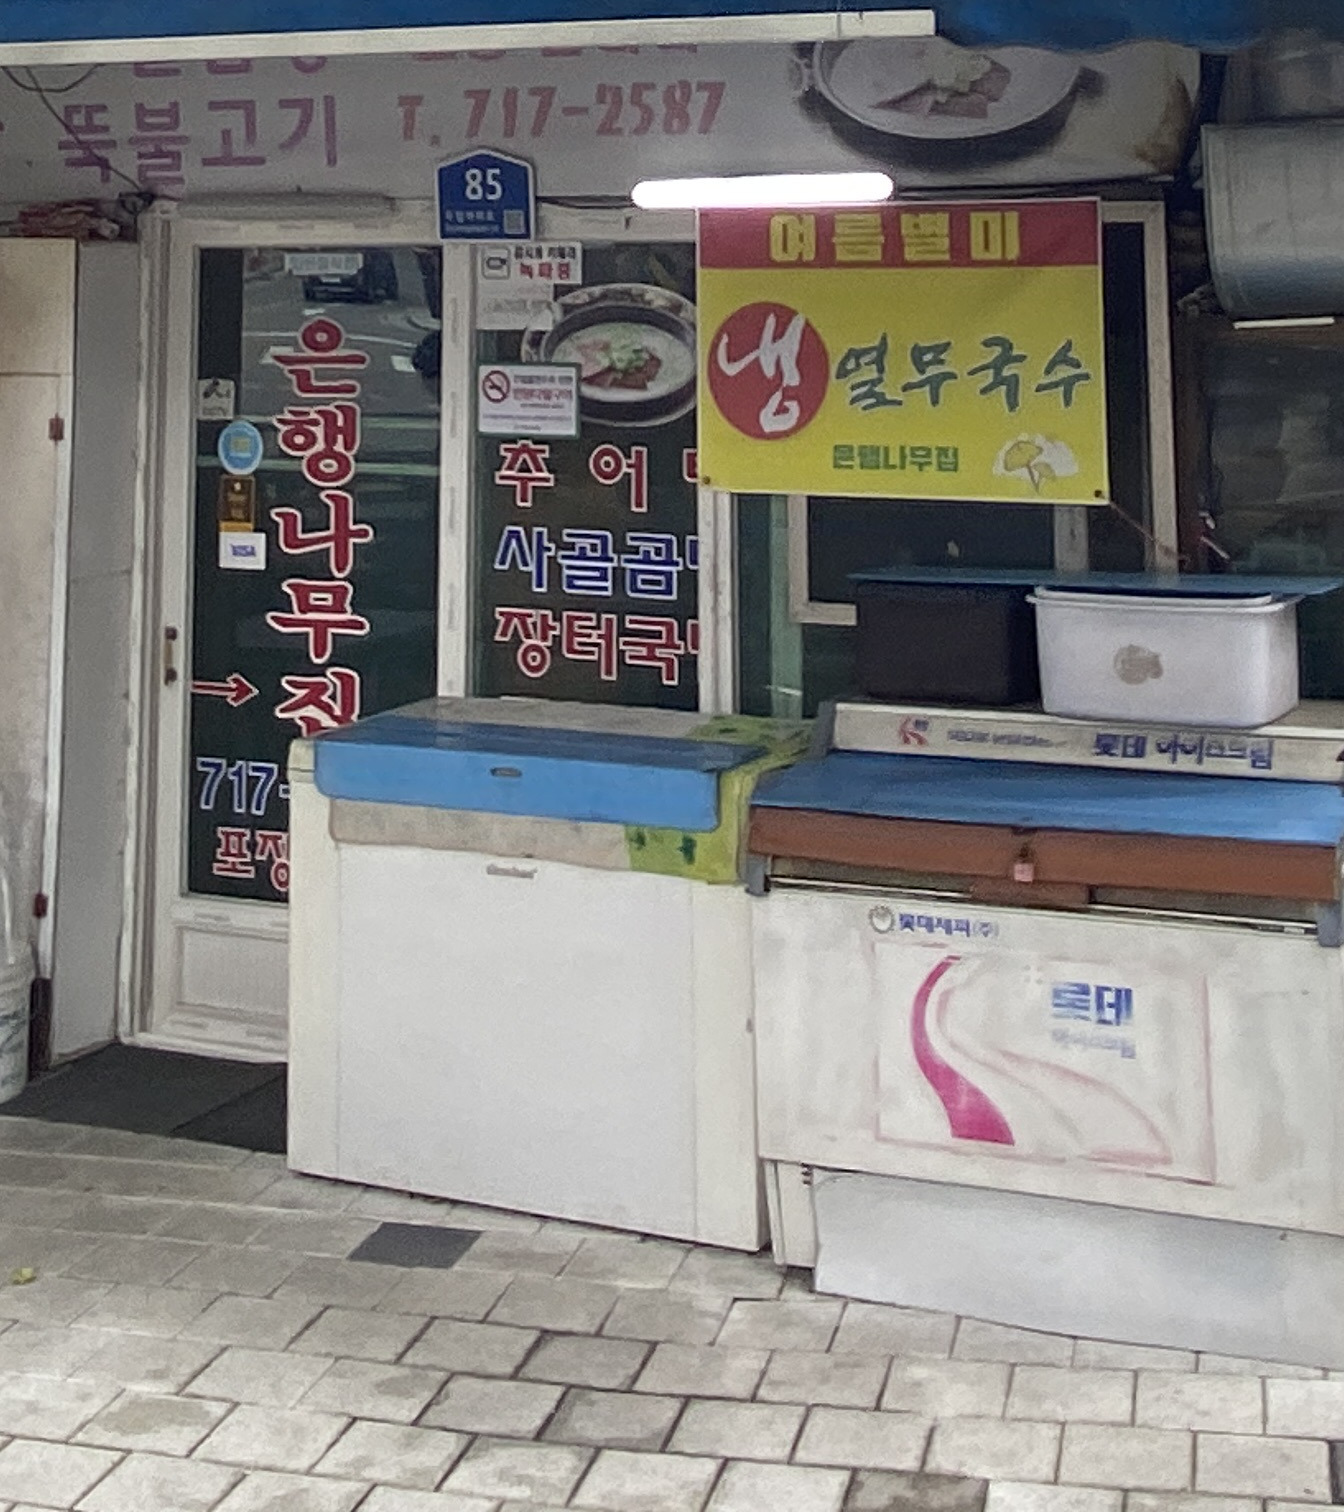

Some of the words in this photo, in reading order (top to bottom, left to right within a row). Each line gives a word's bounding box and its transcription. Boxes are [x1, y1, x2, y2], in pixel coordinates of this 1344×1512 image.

[57, 96, 339, 189] 뚝불고기
[464, 81, 727, 140] 717-2587
[465, 168, 503, 200] 85
[769, 209, 1021, 263] 여름별미
[717, 311, 806, 434] 냉
[834, 332, 1092, 414] 열무국수
[832, 444, 959, 472] 은행나무집
[266, 317, 374, 738] 은행나무집
[1094, 731, 1148, 760] 롯데
